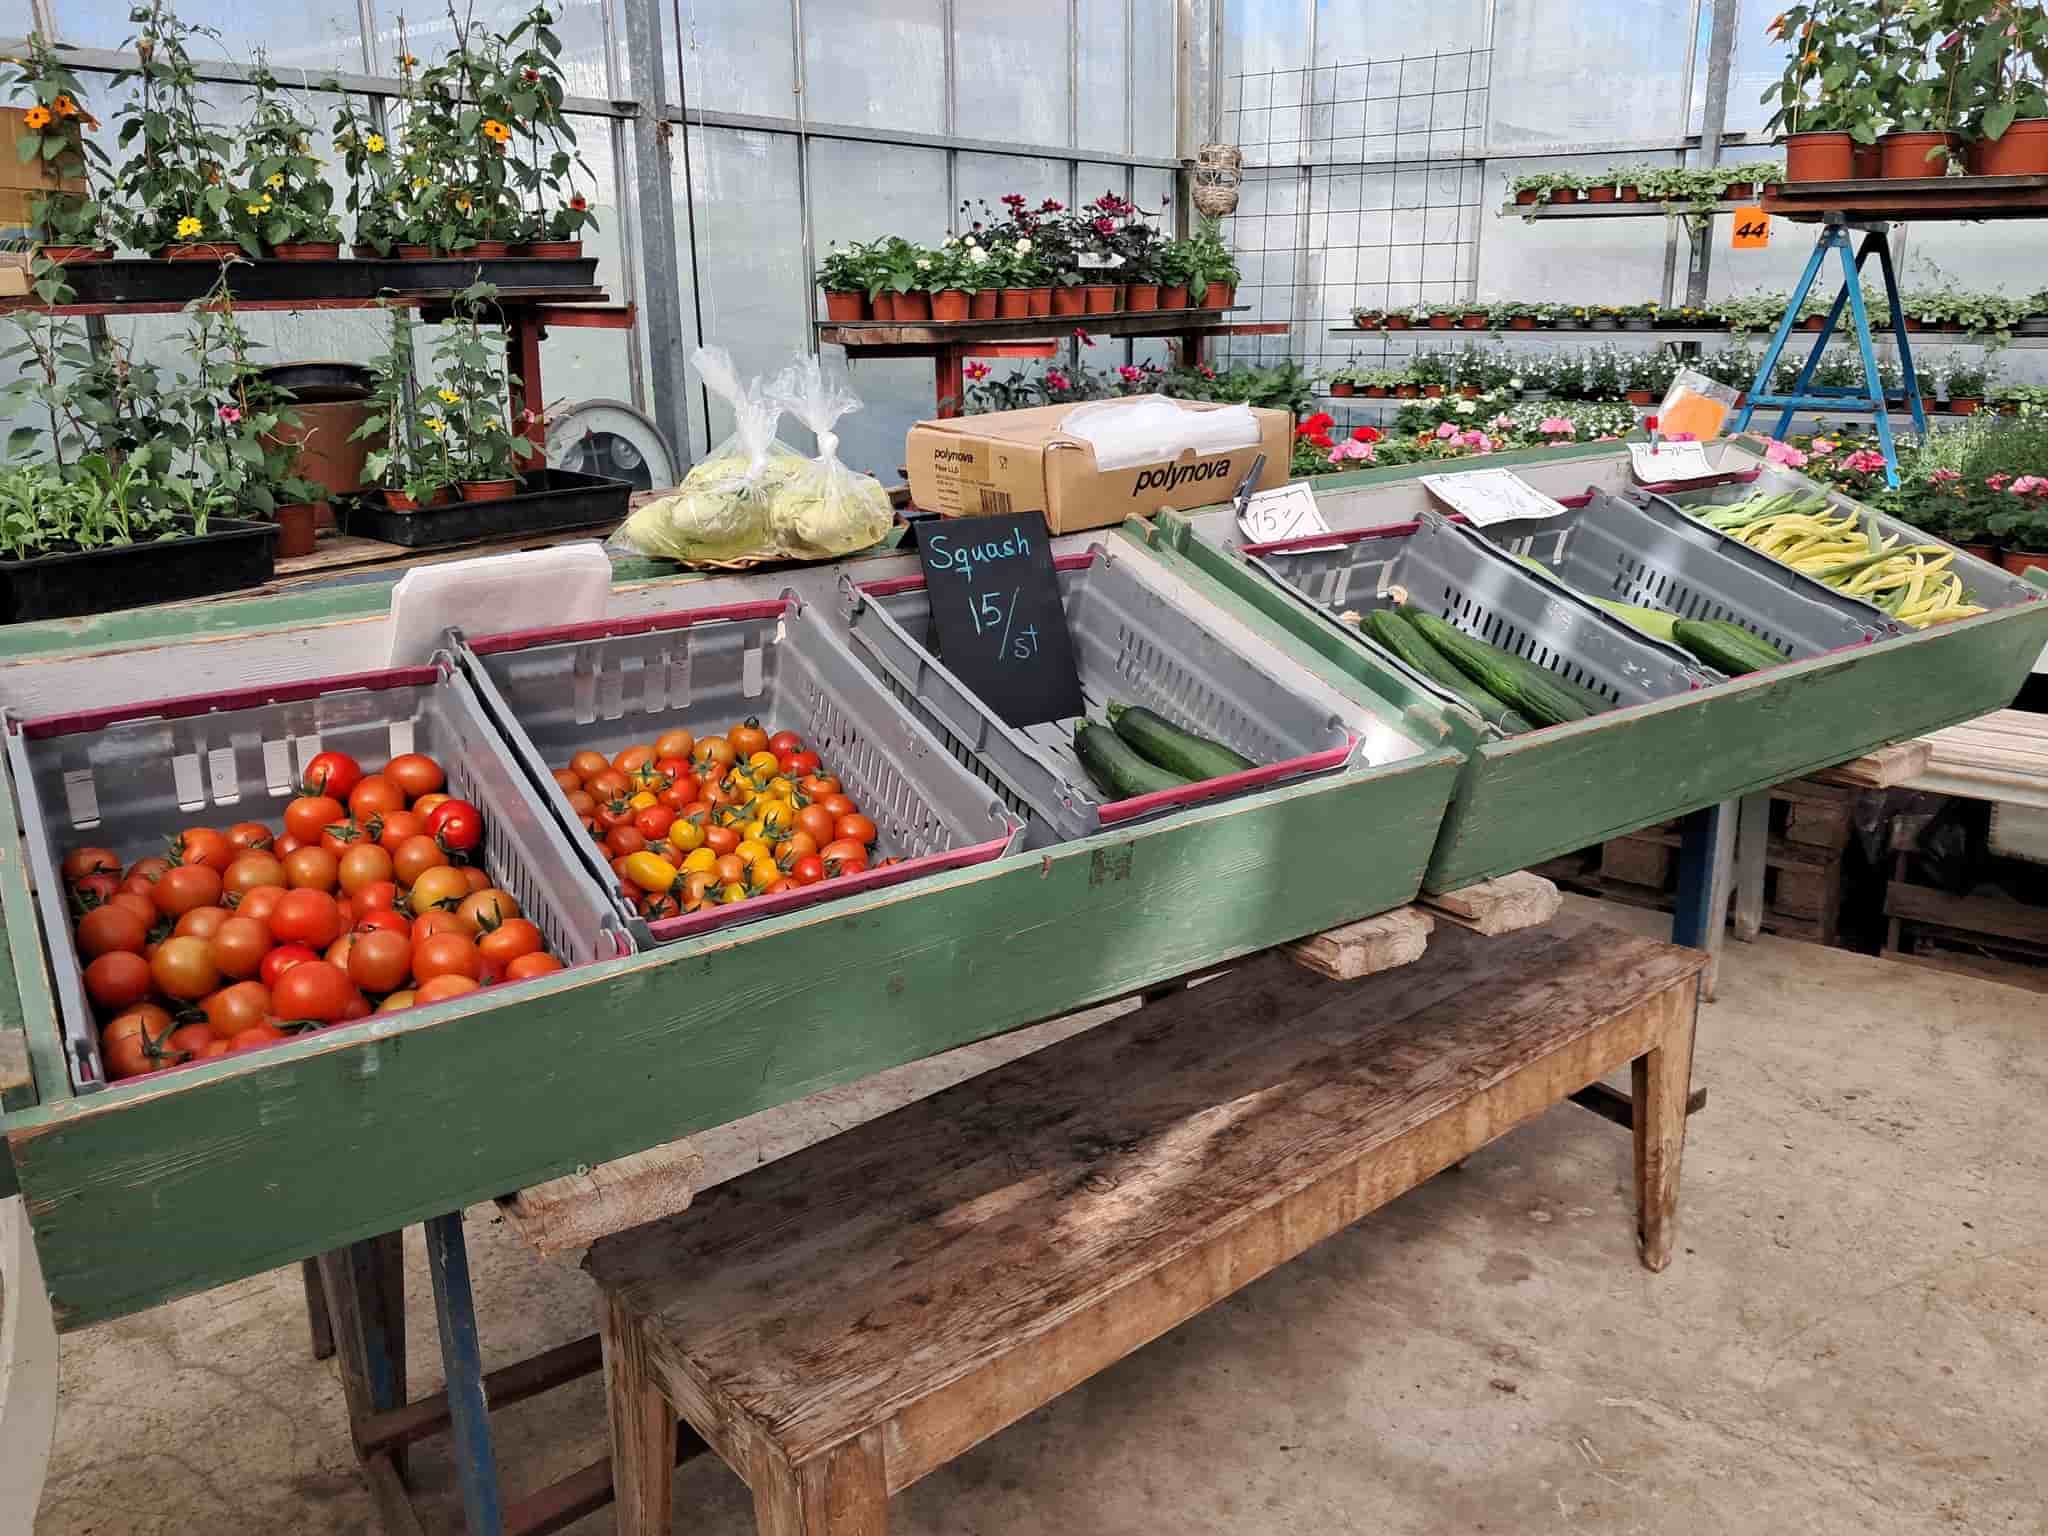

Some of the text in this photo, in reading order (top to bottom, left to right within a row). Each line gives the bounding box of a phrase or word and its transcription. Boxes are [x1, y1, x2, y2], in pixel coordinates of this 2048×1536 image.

[934, 447, 974, 464] polynova
[1132, 458, 1231, 497] polynova
[929, 527, 1031, 583] Squash
